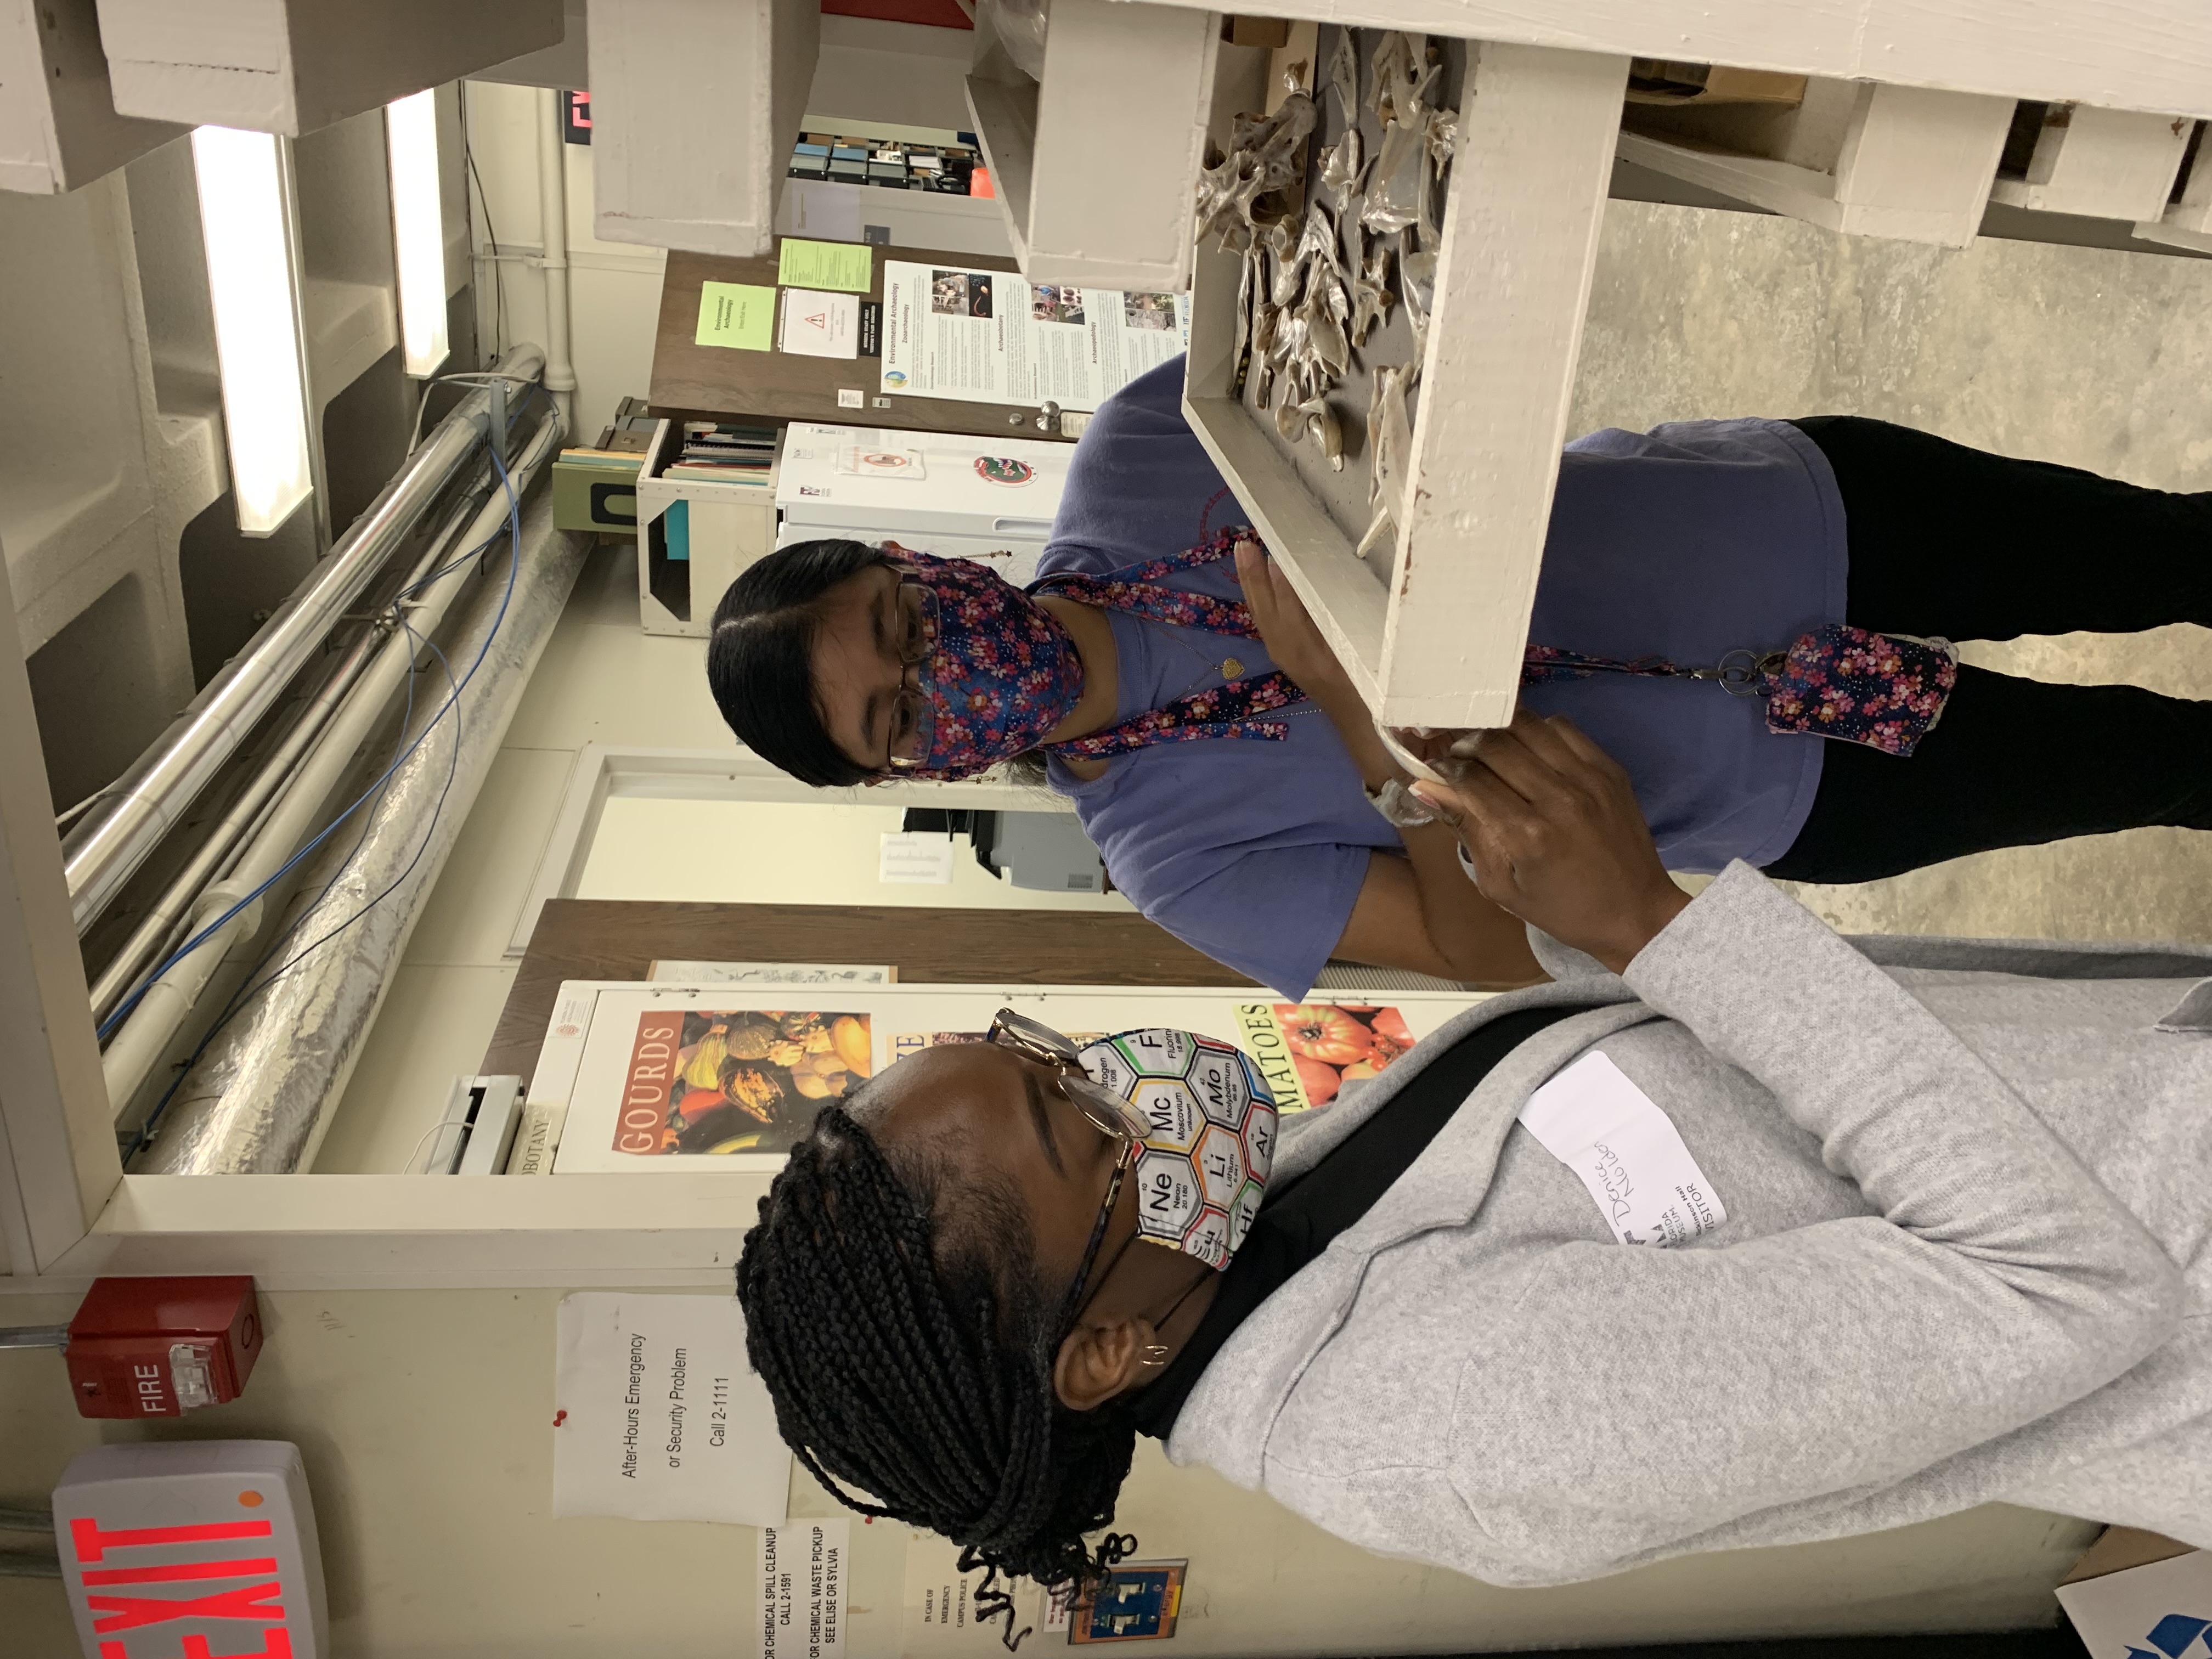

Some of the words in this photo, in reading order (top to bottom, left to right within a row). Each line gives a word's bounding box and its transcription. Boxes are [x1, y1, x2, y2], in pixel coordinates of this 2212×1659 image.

[714, 296, 724, 331] Environmental
[724, 299, 733, 329] Archaeology
[890, 282, 899, 318] Archaeology
[901, 303, 910, 343] Zooarchaeology
[888, 319, 898, 364] Environmental
[1139, 1035, 1163, 1048] F
[1175, 1032, 1183, 1053] 18.998
[1099, 1057, 1110, 1088] drogen
[1199, 1077, 1205, 1086] 42
[1207, 1069, 1224, 1106] Mo
[619, 1027, 674, 1153] GOURDS
[1224, 1063, 1233, 1118] Molybdenum
[1149, 1097, 1173, 1131] Mc
[1175, 1092, 1186, 1141] Moscovium
[1256, 1126, 1268, 1159] Ar
[1209, 1154, 1226, 1177] Li
[1226, 1154, 1234, 1188] Lithium
[1142, 1183, 1148, 1192] 10
[1149, 1173, 1172, 1212] Ne
[1173, 1183, 1182, 1209] Neon
[1594, 1161, 1630, 1227] Denice
[1675, 1185, 1688, 1201] Hall
[1686, 1182, 1714, 1231] VISITOR
[1661, 1211, 1678, 1246] FLORIDA
[625, 1333, 646, 1404] Emergency
[669, 1348, 687, 1400] Problem
[134, 1364, 166, 1412] FIRE
[712, 1378, 729, 1420] 2-1111
[622, 1408, 639, 1479] After-Hours
[666, 1403, 687, 1452] Security
[709, 1423, 725, 1447] Call
[669, 1455, 680, 1468] or
[765, 1527, 776, 1572] CLEANUP
[812, 1526, 823, 1561] PICKUP
[811, 1564, 822, 1598] WASTE
[827, 1548, 838, 1581] SYLVIA
[70, 1517, 293, 1659] EXIT
[765, 1575, 776, 1600] SPILL
[781, 1573, 791, 1600] 2-1591
[826, 1583, 837, 1596] OR
[927, 1589, 933, 1597] OF
[941, 1584, 951, 1623] EMERGENCY
[959, 1578, 968, 1601] POLICE
[765, 1602, 775, 1647] CHEMICAL
[780, 1602, 791, 1626] CALL
[810, 1599, 821, 1644] CHEMICAL
[825, 1599, 836, 1624] ELISE
[956, 1601, 966, 1628] CAMPUS
[810, 1645, 820, 1659] OR
[825, 1626, 836, 1644] SEE
